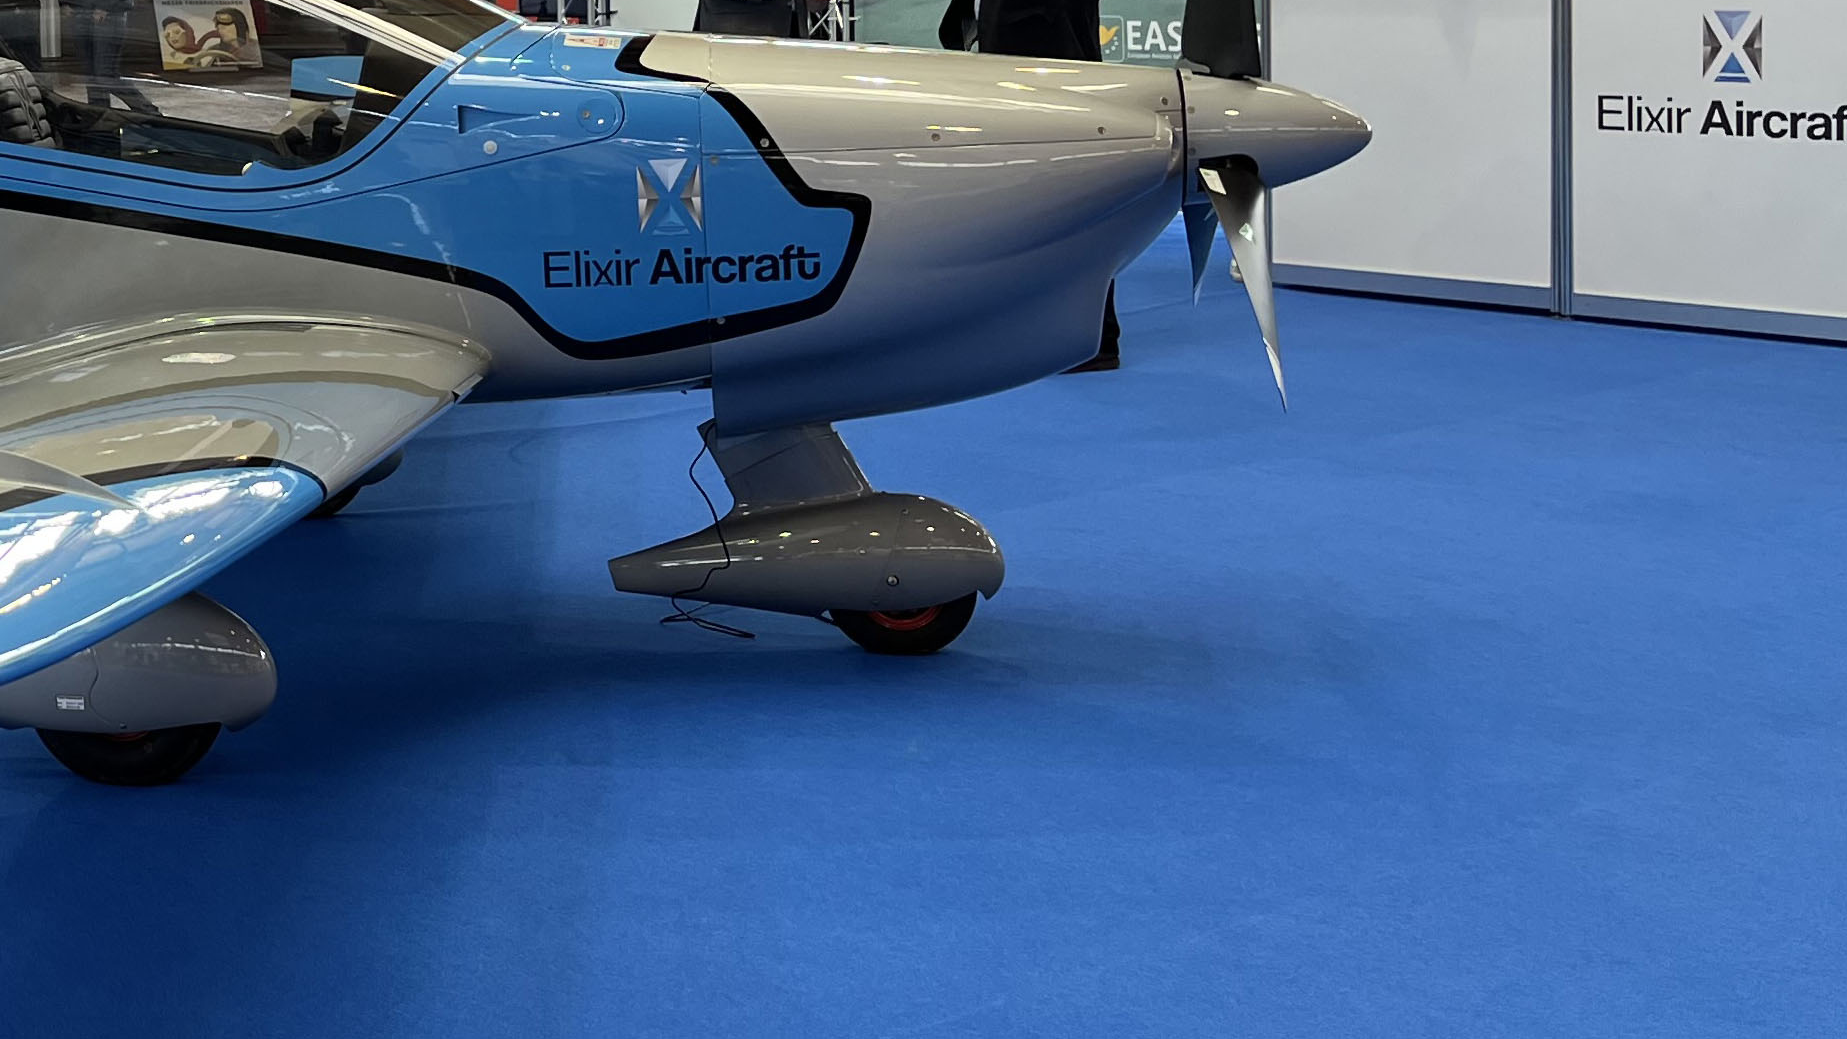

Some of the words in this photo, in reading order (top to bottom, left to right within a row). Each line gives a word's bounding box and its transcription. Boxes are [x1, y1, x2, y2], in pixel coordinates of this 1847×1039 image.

[1126, 20, 1182, 52] EAS
[1597, 94, 1692, 133] Elixir
[1699, 99, 1847, 141] Aircraf
[542, 248, 641, 288] Elixir
[648, 244, 821, 285] Aircraft
